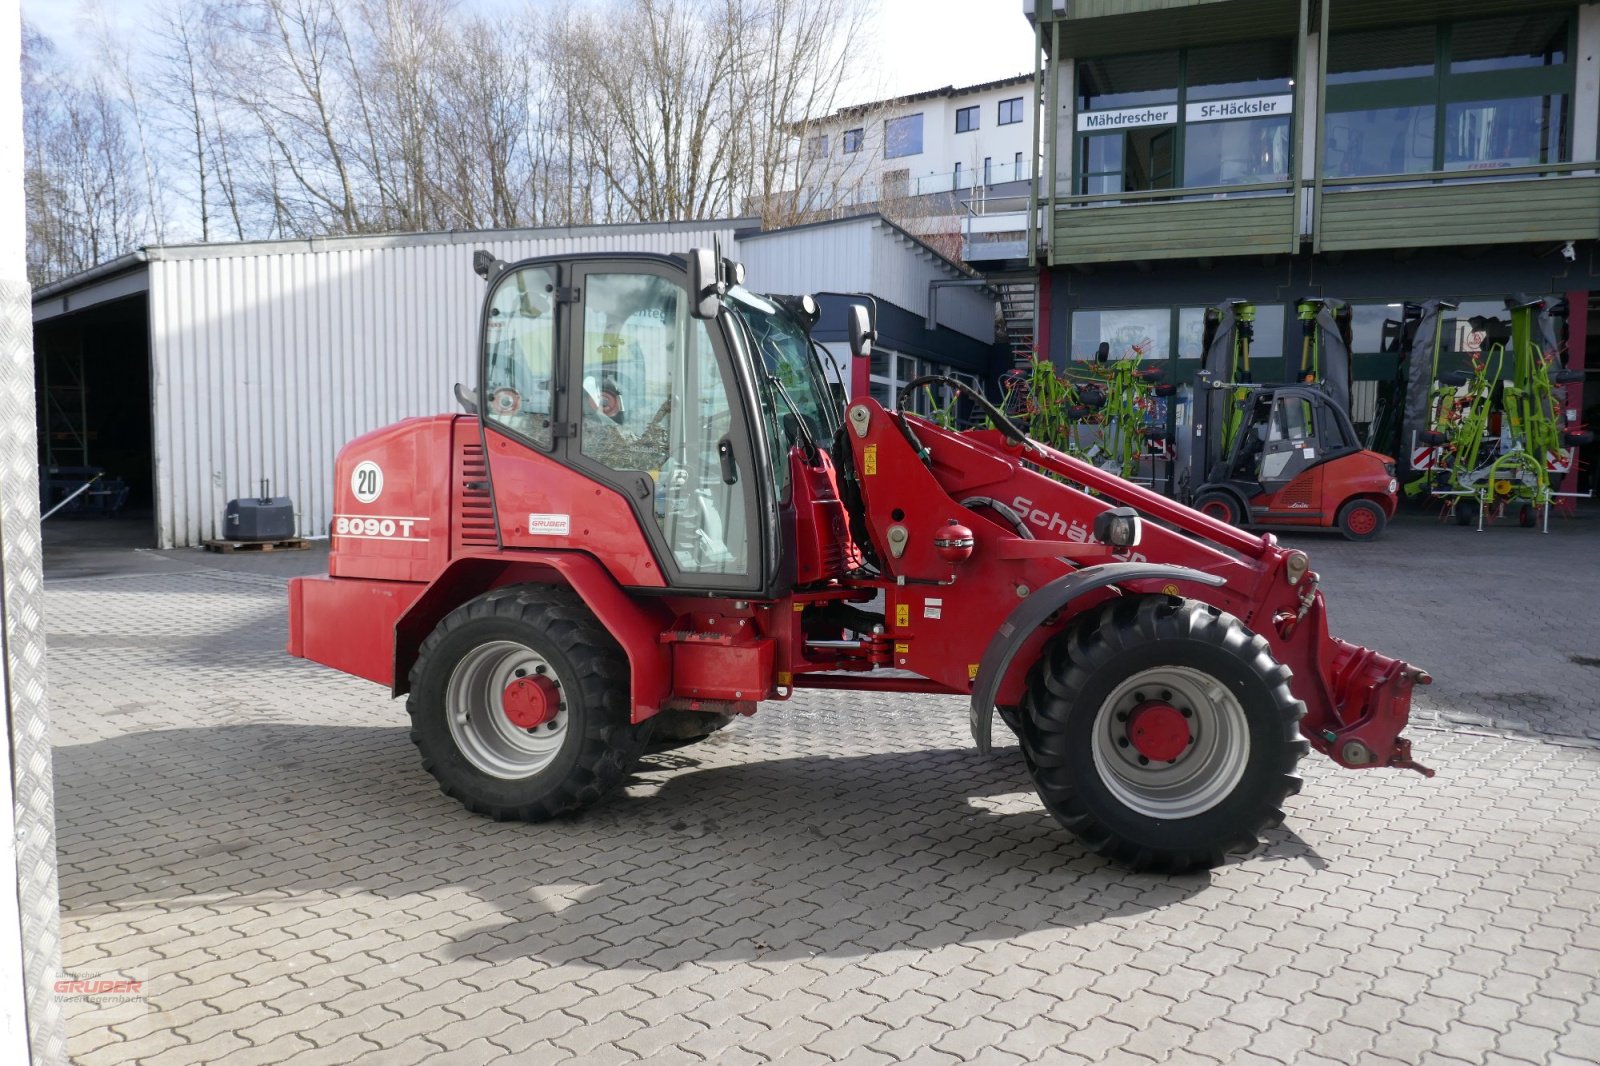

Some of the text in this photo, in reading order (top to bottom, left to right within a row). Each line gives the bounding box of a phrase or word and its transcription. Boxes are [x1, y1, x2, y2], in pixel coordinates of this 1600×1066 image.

[1086, 109, 1169, 127] Mähdrescher
[1200, 100, 1277, 118] SF-Häcksler
[358, 469, 377, 495] 20
[336, 517, 415, 538] 8090 T
